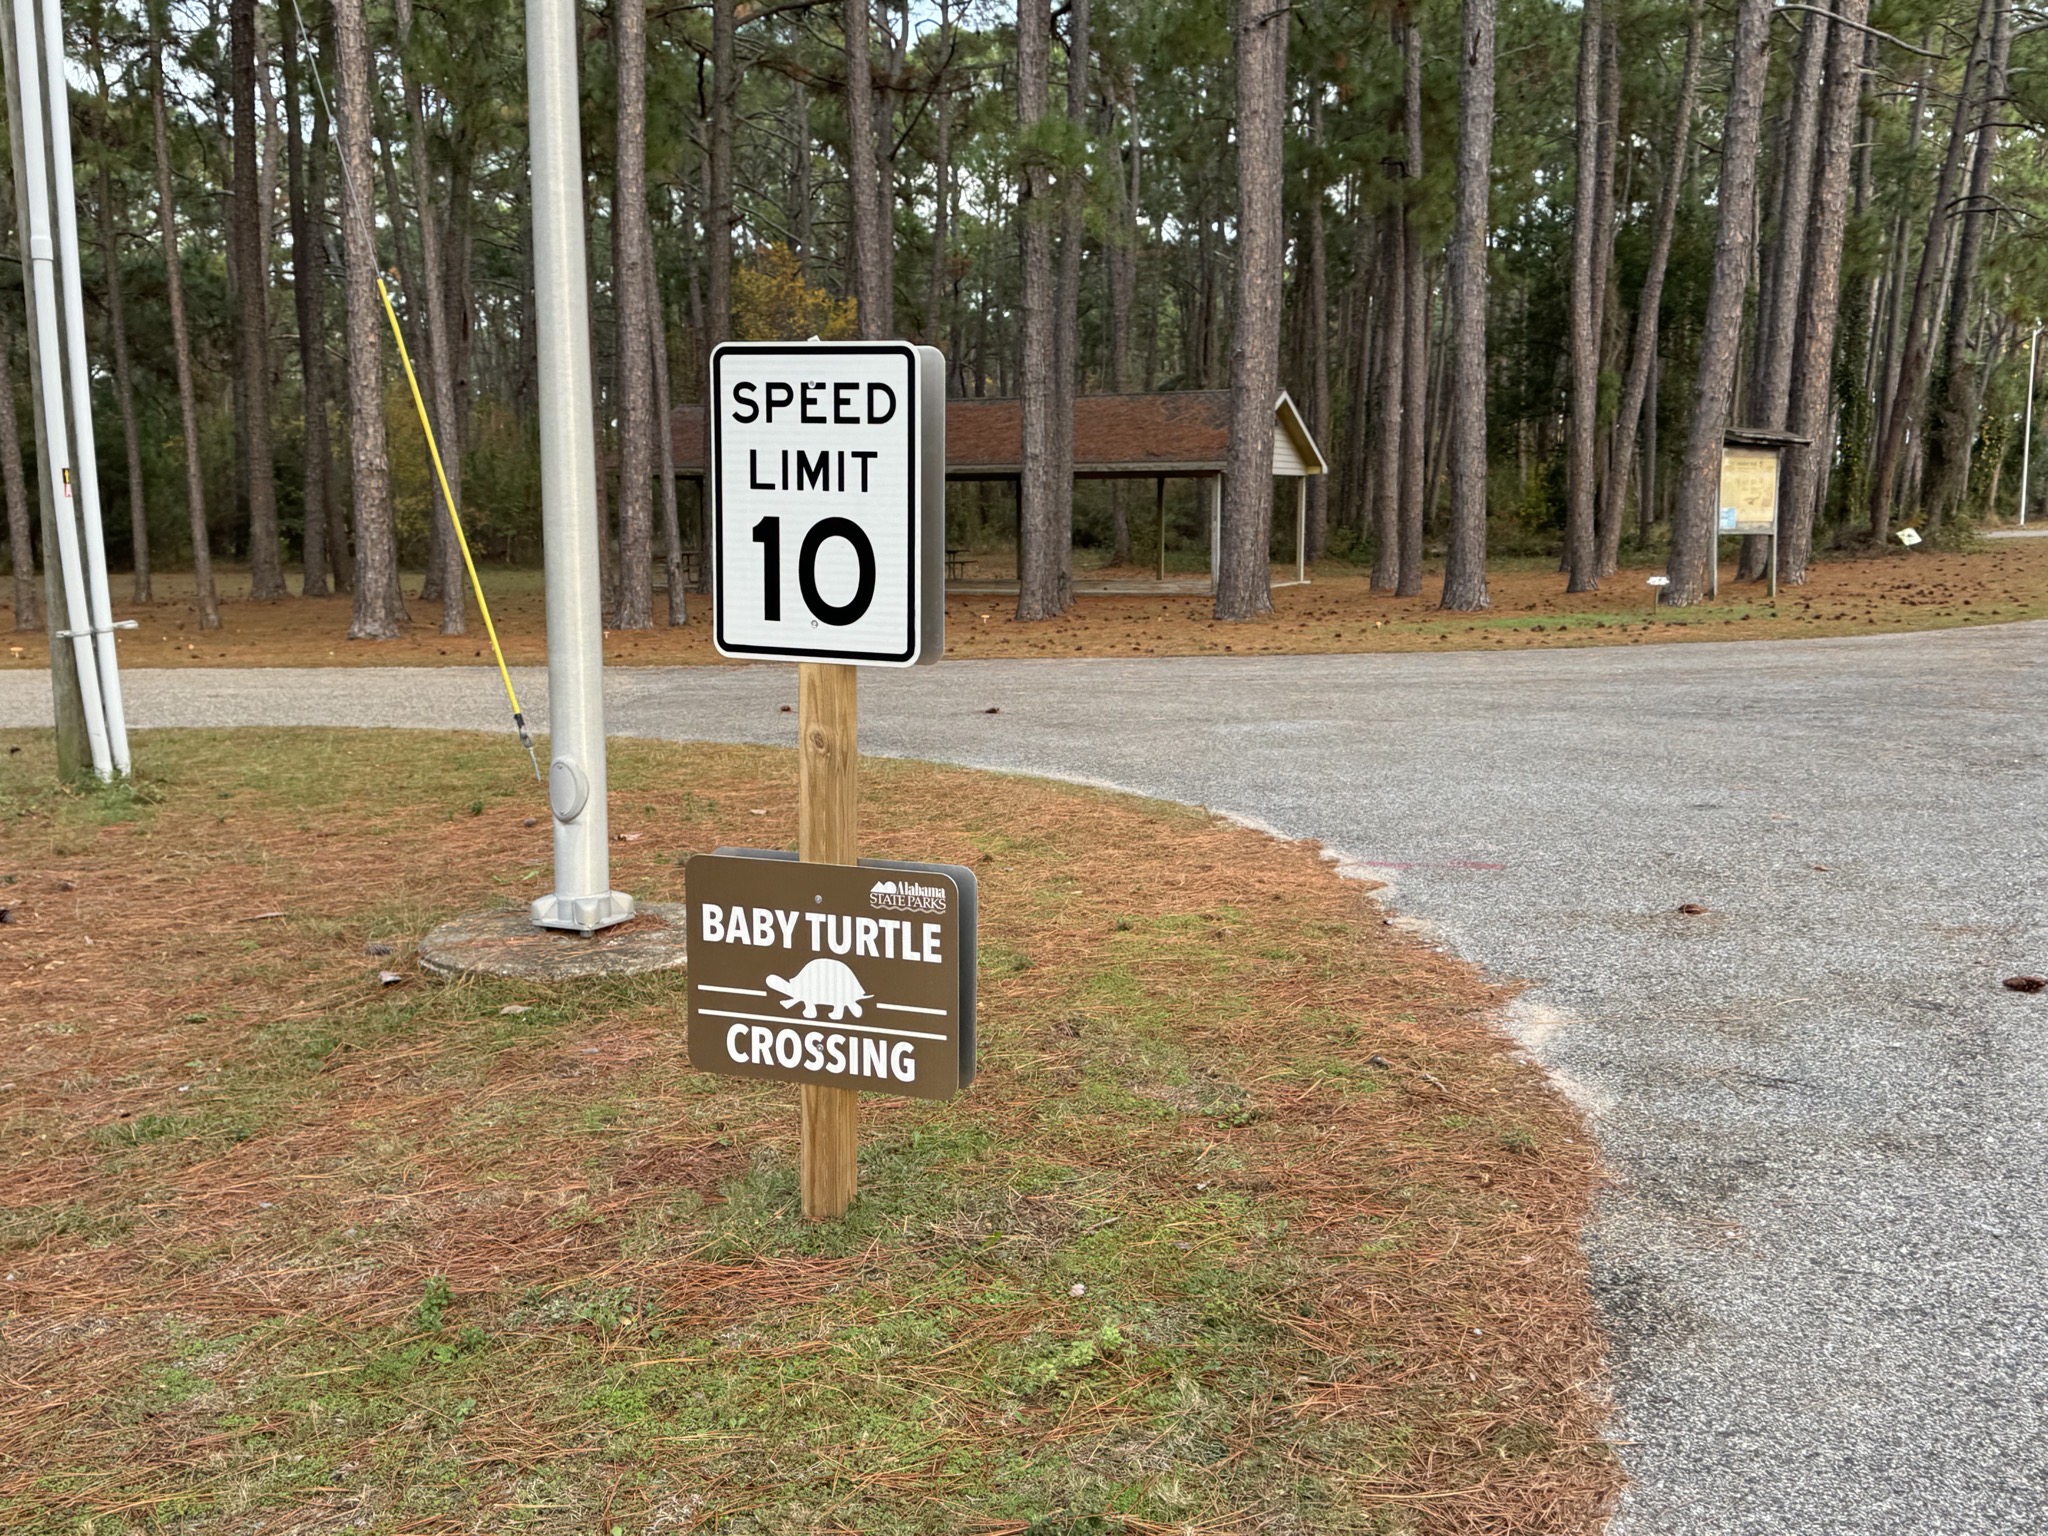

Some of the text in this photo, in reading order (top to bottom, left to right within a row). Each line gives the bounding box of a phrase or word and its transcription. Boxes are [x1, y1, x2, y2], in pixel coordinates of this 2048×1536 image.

[732, 381, 897, 424] SPEED
[749, 449, 878, 493] LIMIT
[752, 516, 876, 626] 10
[870, 892, 947, 910] STATE PARKS
[896, 880, 946, 899] Alabama
[702, 903, 942, 964] BABY TURTLE
[726, 1023, 916, 1083] CROSSING
